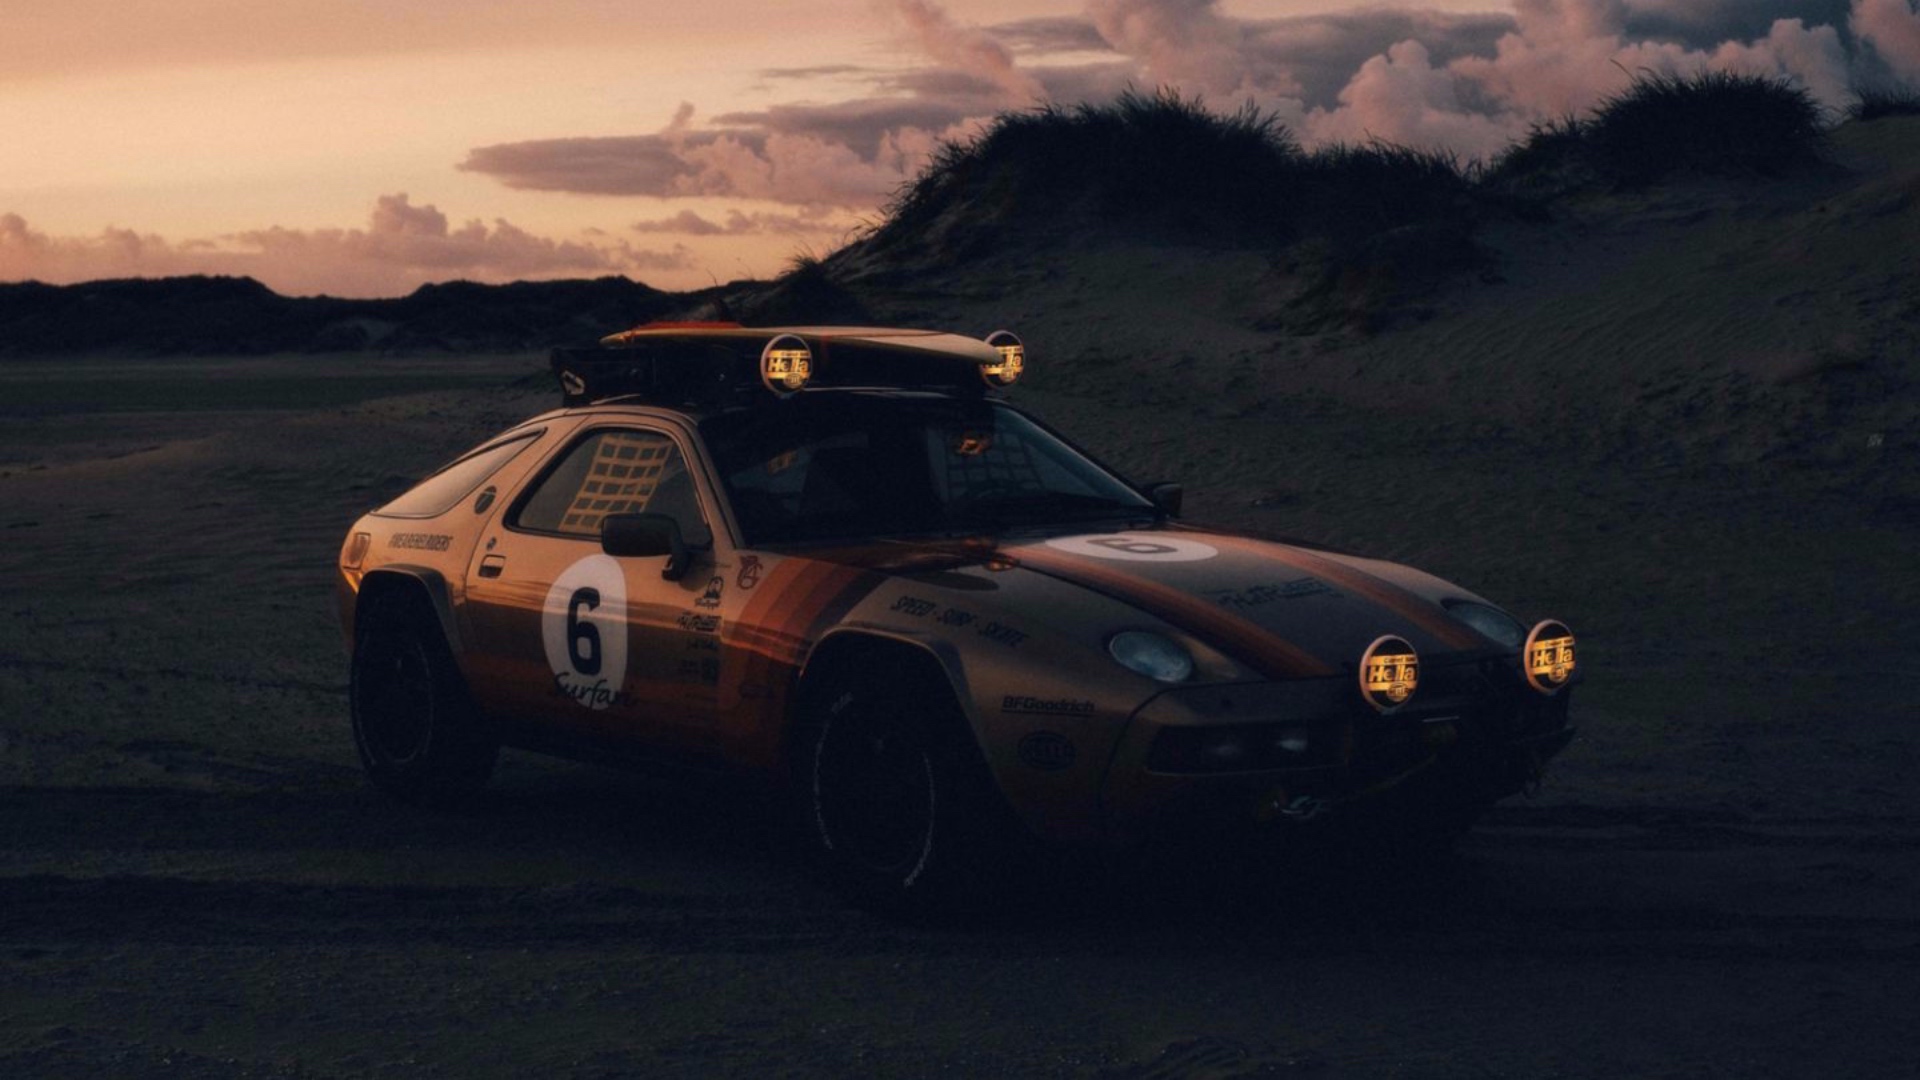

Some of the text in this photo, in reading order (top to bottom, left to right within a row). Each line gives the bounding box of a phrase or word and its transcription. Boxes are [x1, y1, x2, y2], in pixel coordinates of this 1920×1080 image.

[768, 357, 809, 373] Hella
[985, 353, 1022, 367] lla
[1086, 538, 1178, 554] 6
[568, 586, 602, 675] 6
[1533, 645, 1574, 668] Hella
[1368, 664, 1416, 682] Hella
[1002, 696, 1095, 713] BFGoodrich
